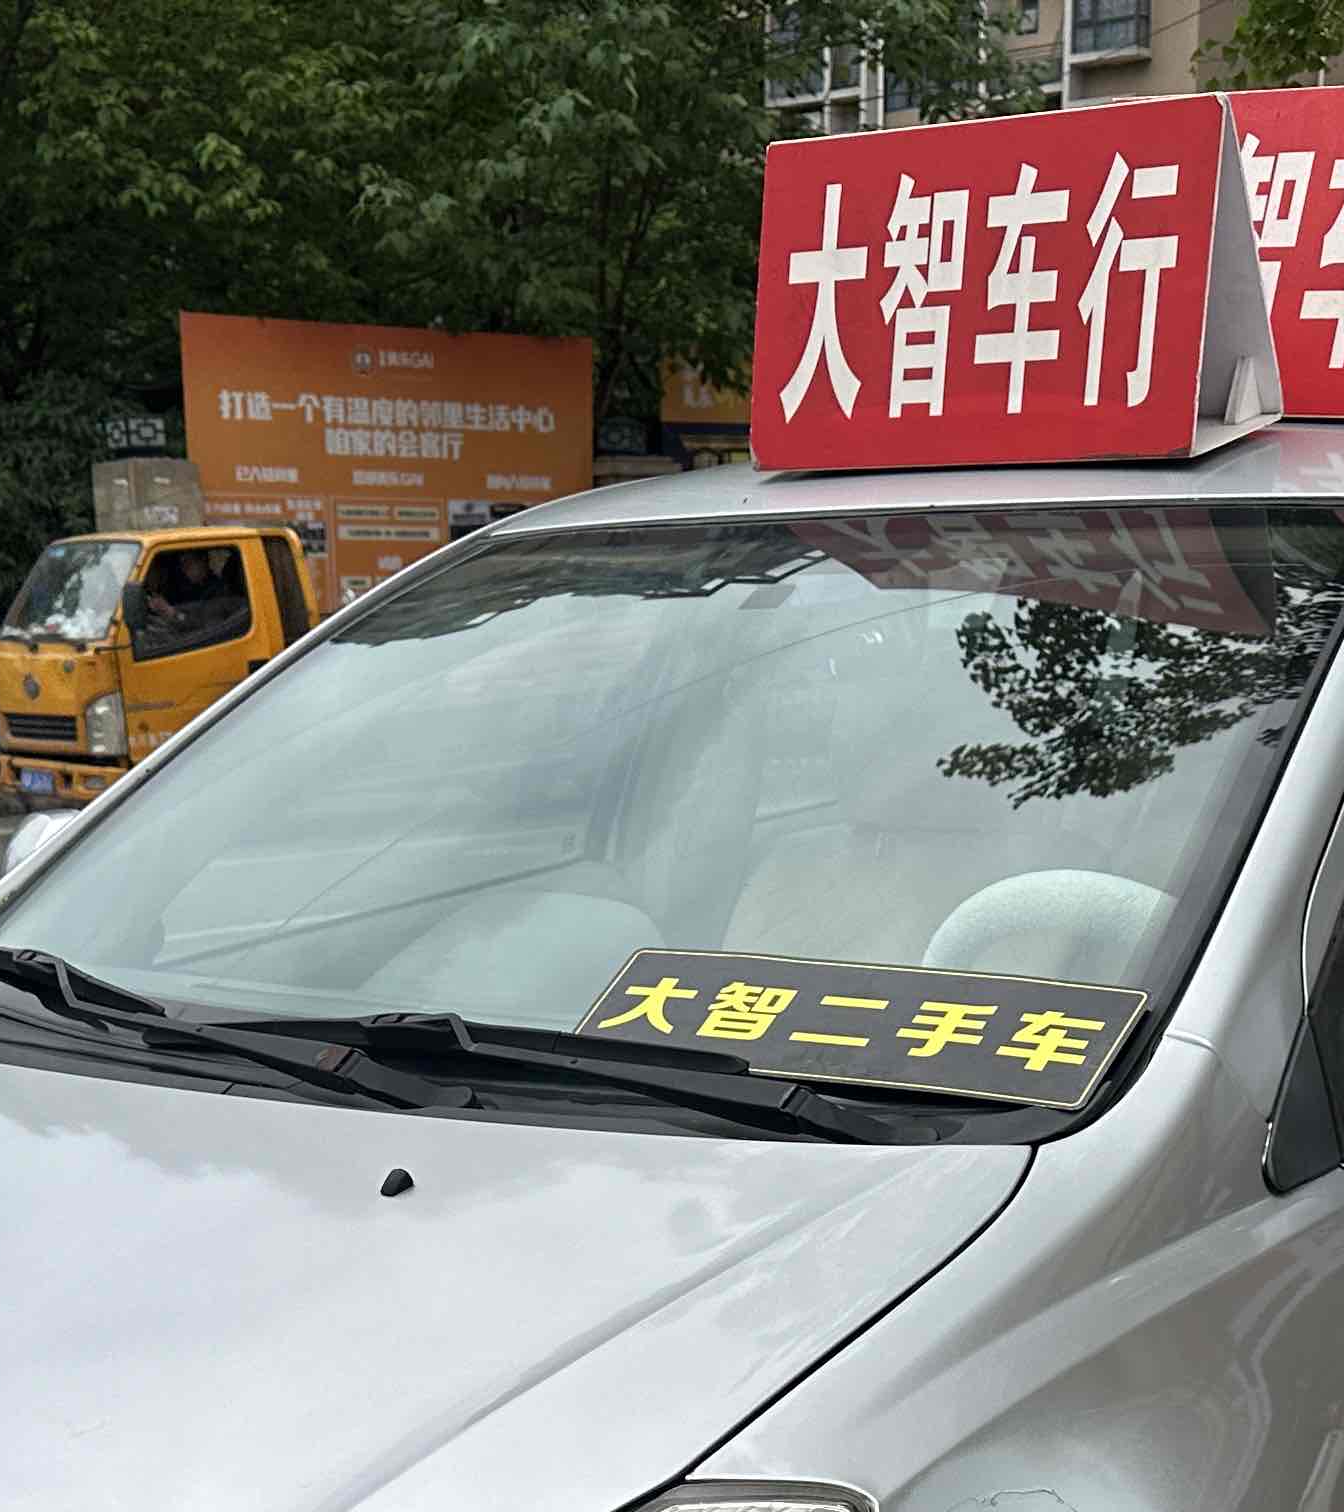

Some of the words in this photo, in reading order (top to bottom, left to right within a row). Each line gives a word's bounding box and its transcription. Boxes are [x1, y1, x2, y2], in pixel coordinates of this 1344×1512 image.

[779, 152, 1180, 424] 大智车行
[597, 977, 1106, 1072] 大智二手车
